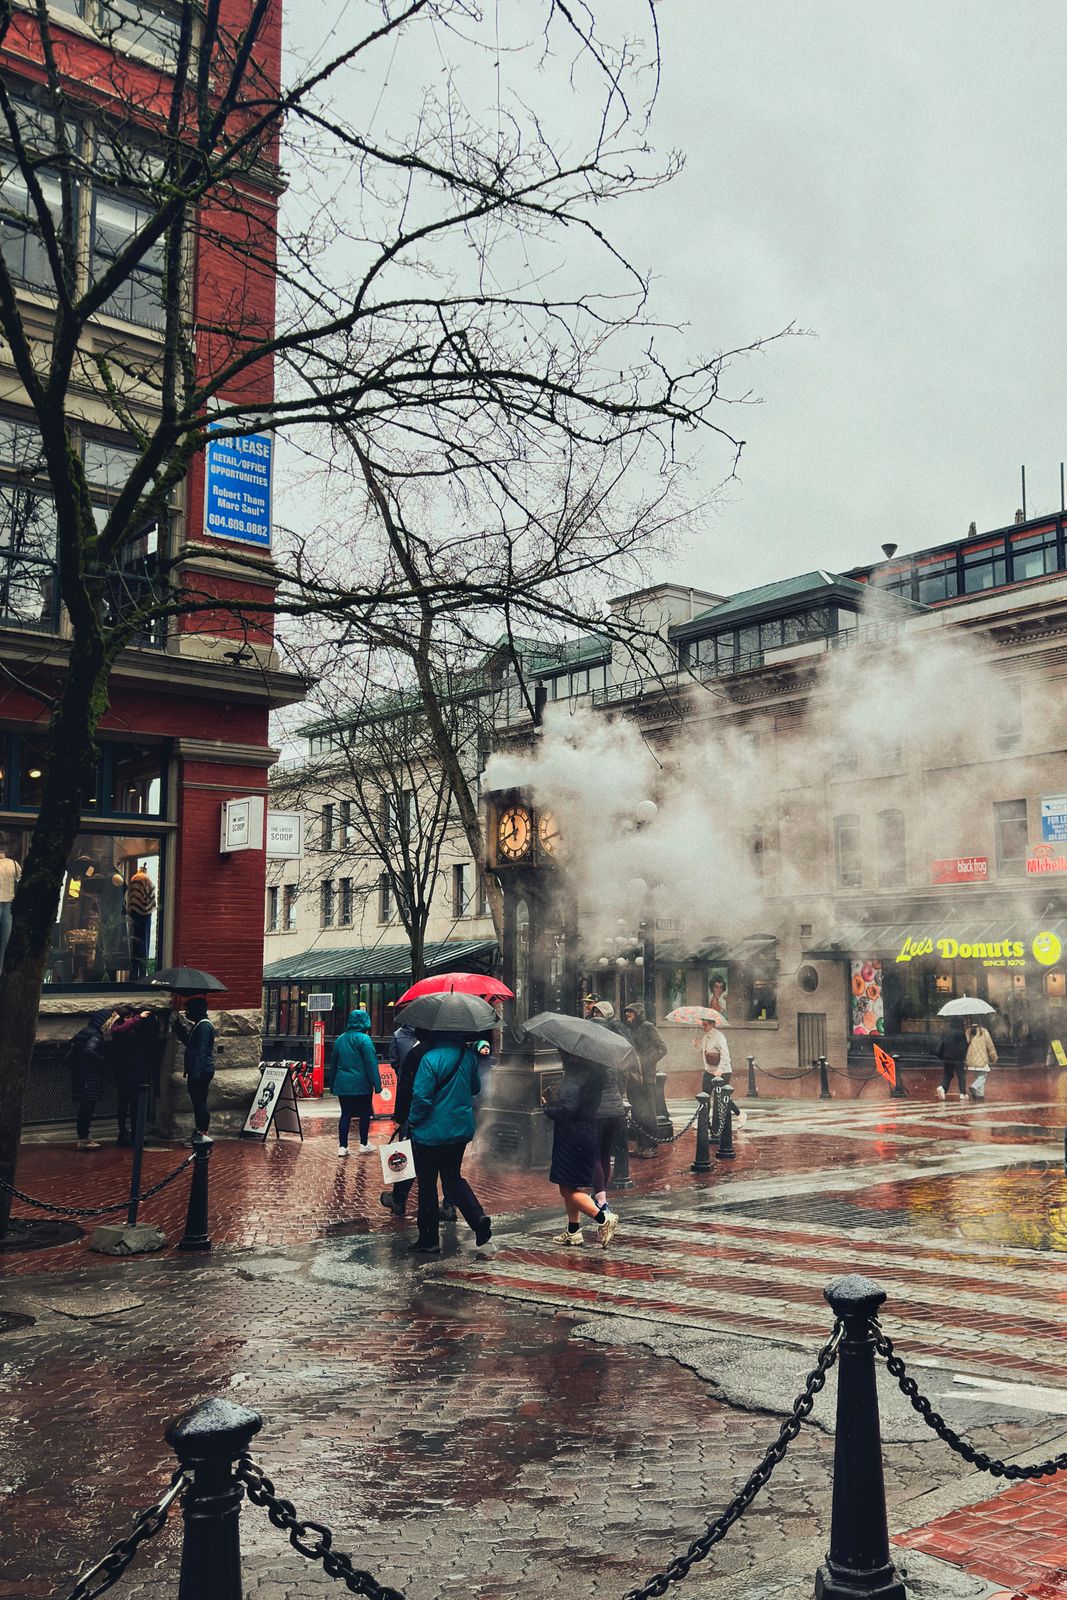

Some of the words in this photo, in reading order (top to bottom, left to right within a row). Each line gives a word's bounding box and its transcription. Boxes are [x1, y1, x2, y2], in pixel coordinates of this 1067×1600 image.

[235, 437, 269, 458] LEASE
[212, 451, 267, 475] RETAIL/OFFICE
[210, 464, 269, 488] OPPORTUNITIES
[212, 485, 241, 501] Robert
[243, 492, 266, 507] Tham
[217, 497, 240, 512] Marc
[271, 832, 293, 841] SCOOP
[957, 859, 973, 873] black
[973, 858, 987, 875] frog
[896, 936, 934, 963] Lee's
[936, 937, 1025, 959] Donuts
